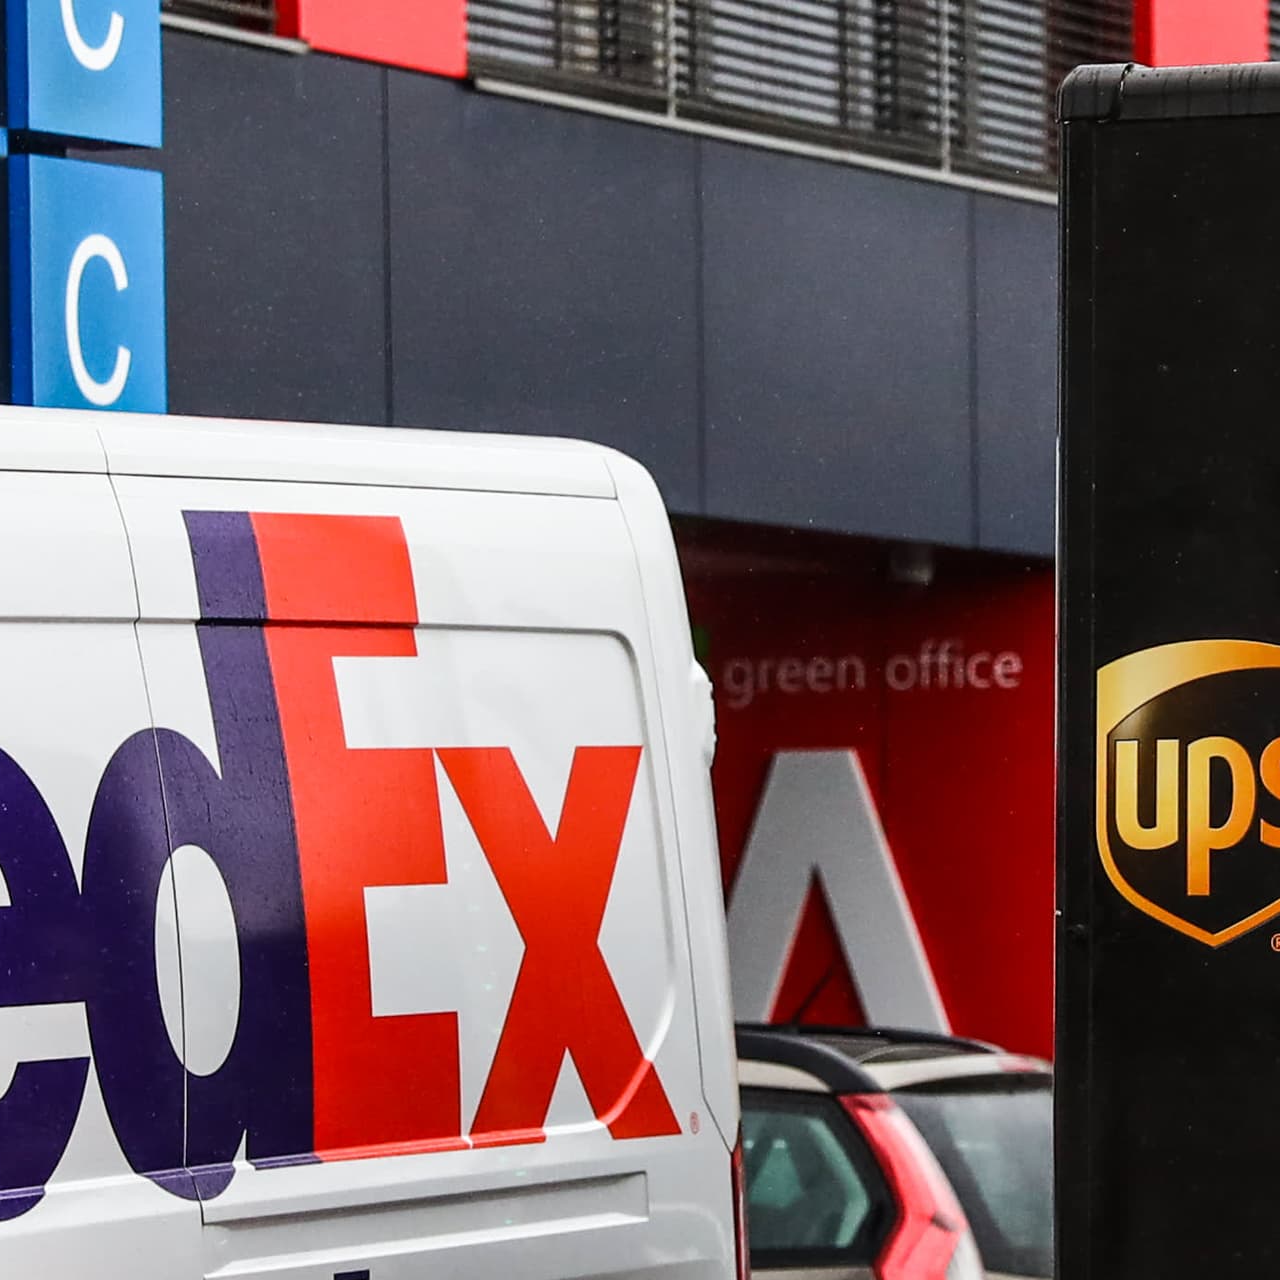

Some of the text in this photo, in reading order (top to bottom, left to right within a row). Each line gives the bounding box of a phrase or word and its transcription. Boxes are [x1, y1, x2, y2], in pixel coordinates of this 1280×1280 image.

[65, 233, 131, 406] C
[722, 637, 1024, 710] green office
